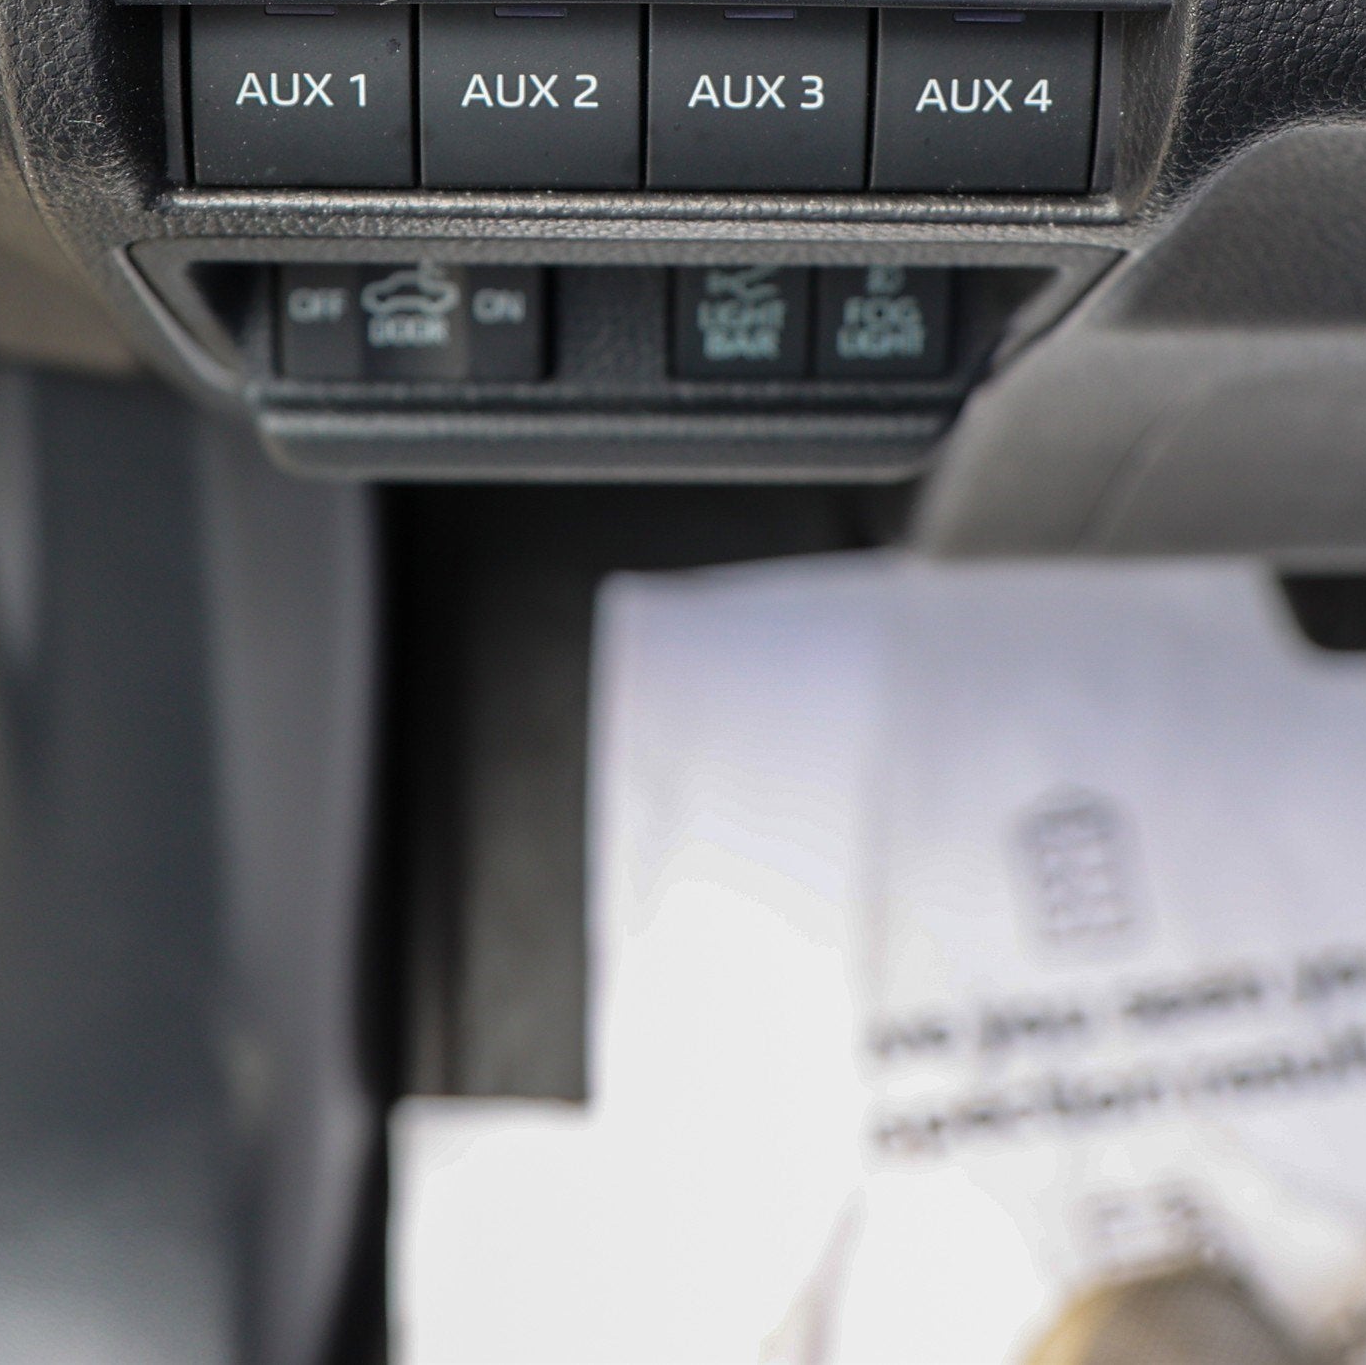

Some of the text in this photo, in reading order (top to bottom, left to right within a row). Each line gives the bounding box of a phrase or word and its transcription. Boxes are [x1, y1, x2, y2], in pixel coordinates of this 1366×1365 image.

[236, 72, 369, 109] AUX 1
[461, 73, 601, 110] AUX 2
[688, 74, 826, 111] AUX 3
[915, 78, 1054, 114] AUX 4
[288, 289, 347, 323] OFF
[472, 290, 526, 324] ON
[843, 297, 923, 326] FOG
